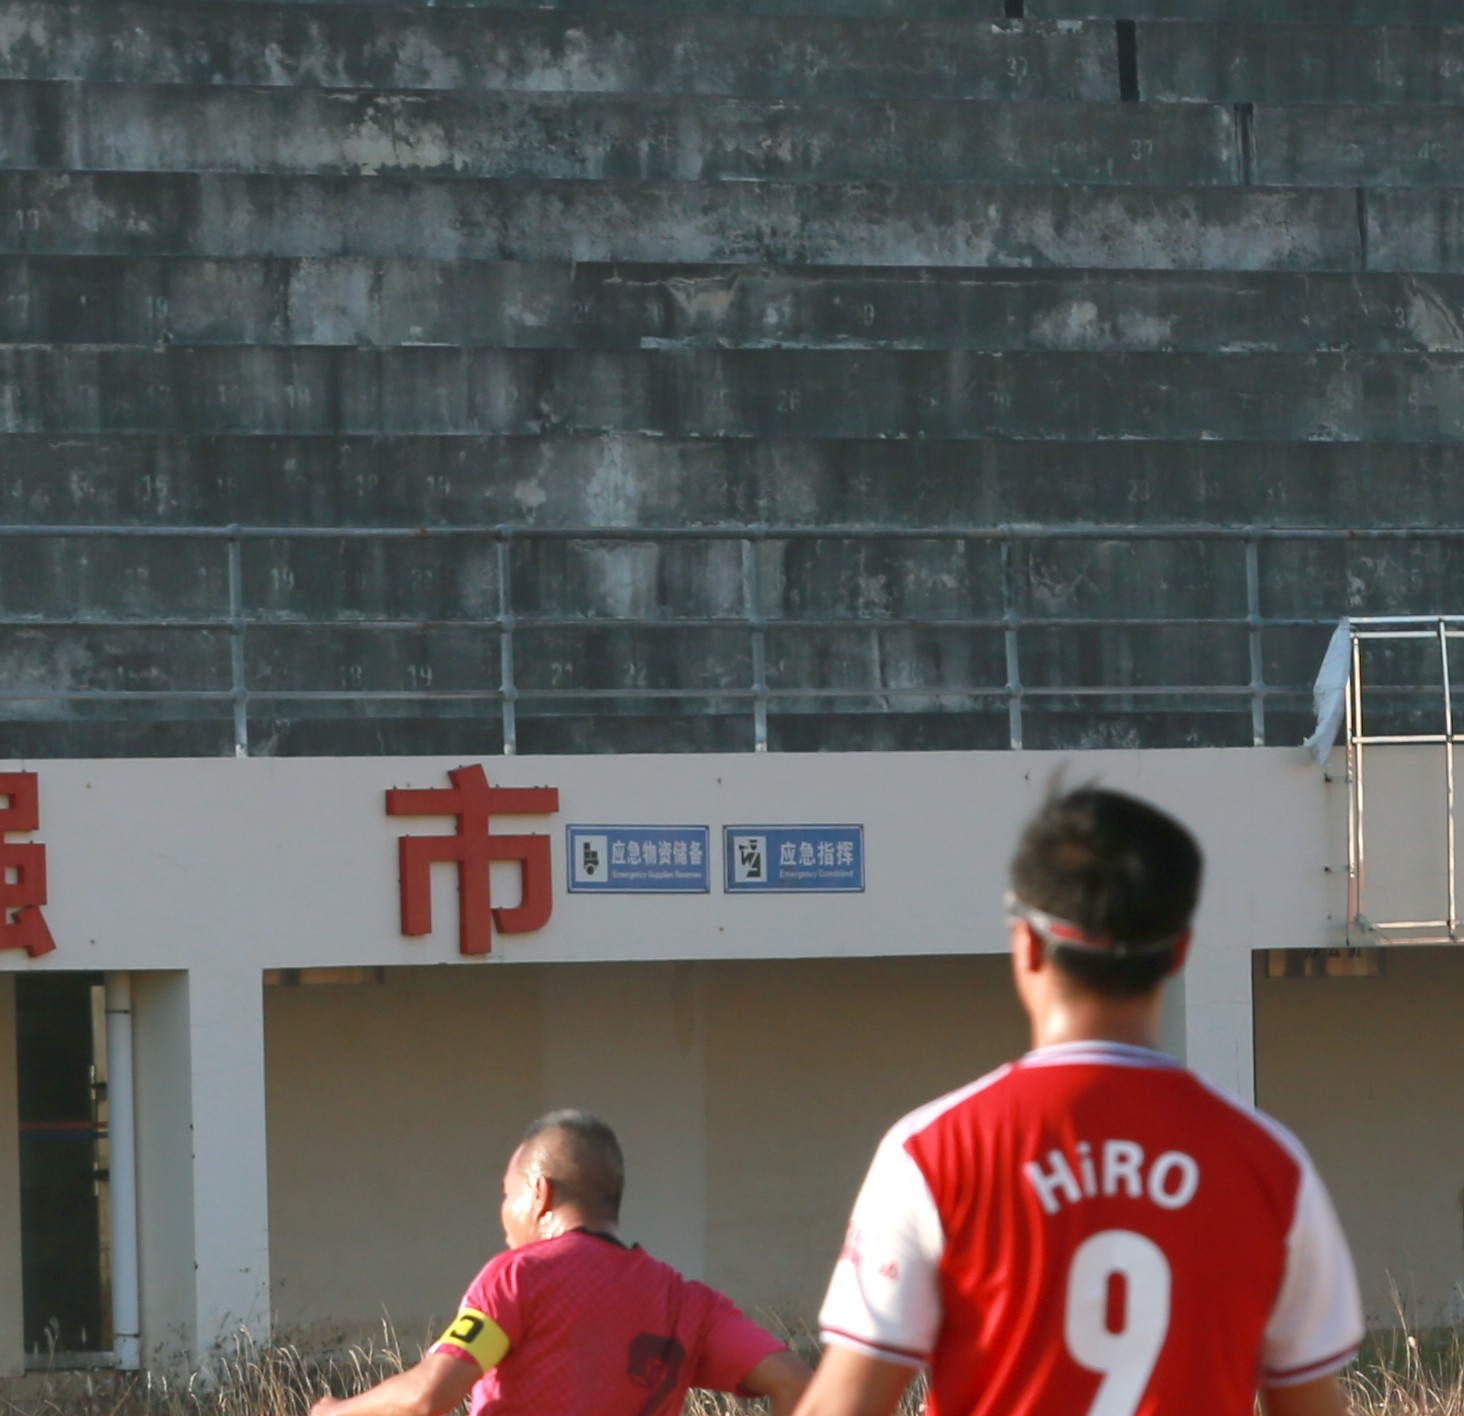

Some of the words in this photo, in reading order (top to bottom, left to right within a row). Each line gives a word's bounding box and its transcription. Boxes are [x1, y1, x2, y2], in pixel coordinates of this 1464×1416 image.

[612, 840, 703, 866] 应急物资储备
[779, 841, 854, 866] 应急指挥
